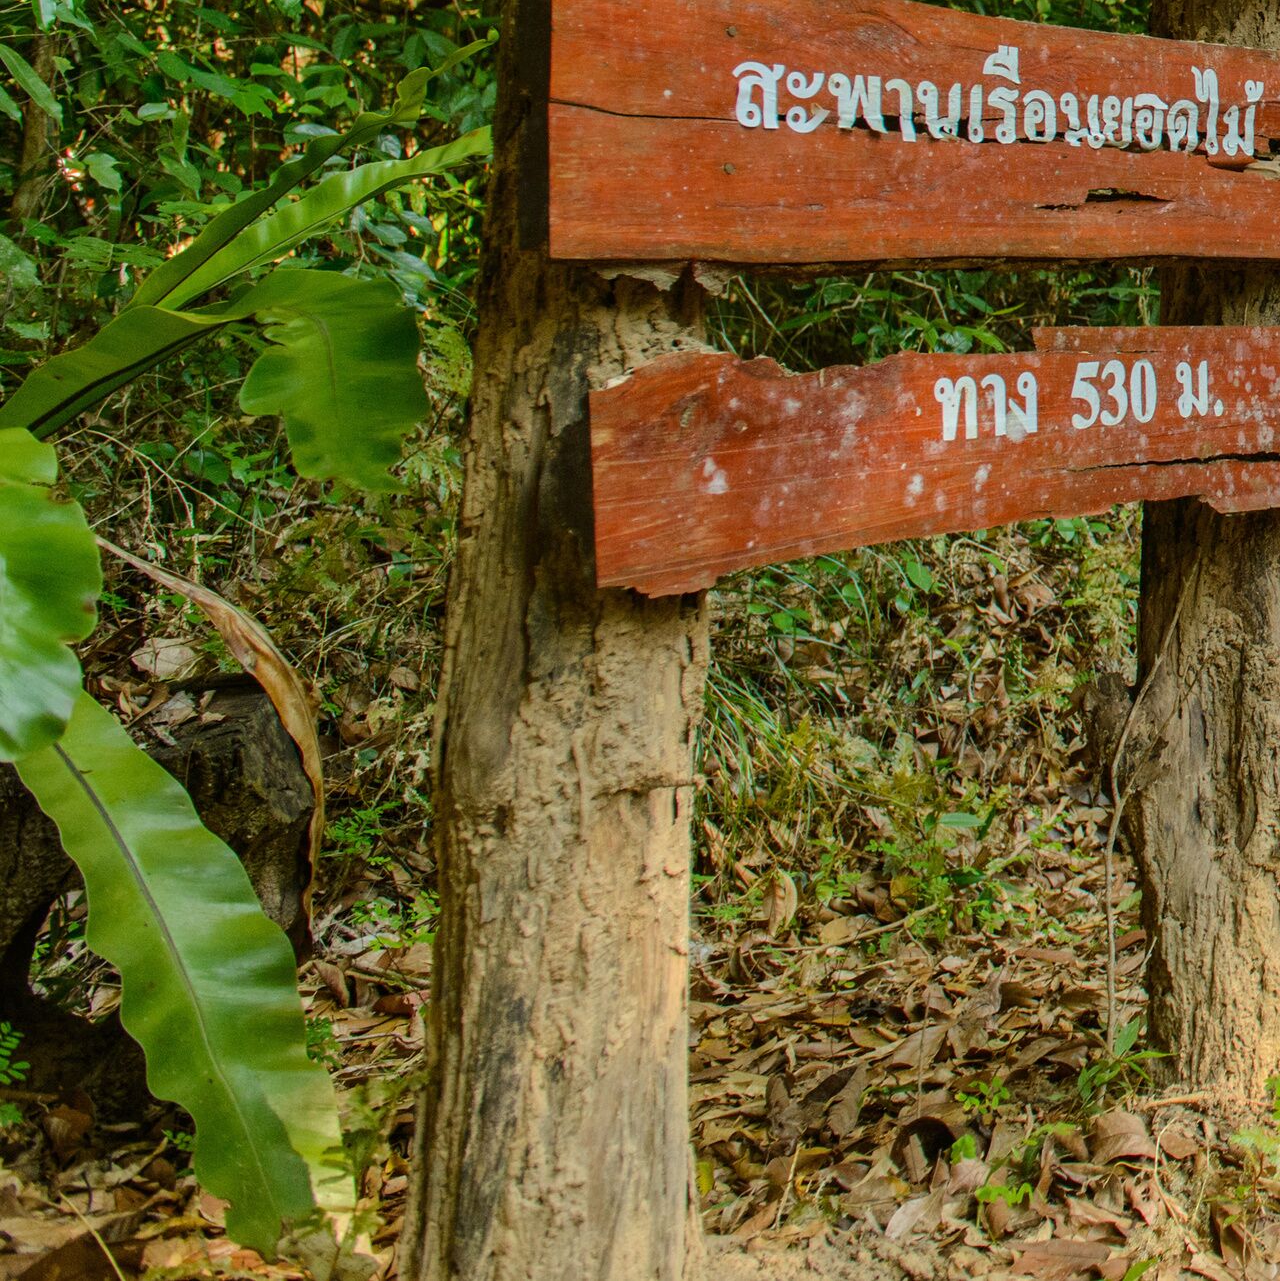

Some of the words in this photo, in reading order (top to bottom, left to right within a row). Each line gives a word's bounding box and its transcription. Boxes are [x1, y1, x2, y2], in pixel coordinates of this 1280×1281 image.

[732, 45, 1265, 157] สะพานเรือนยอดไม้
[933, 371, 1038, 442] ทาง
[1070, 359, 1158, 430] 530
[1175, 360, 1224, 418] ม.
